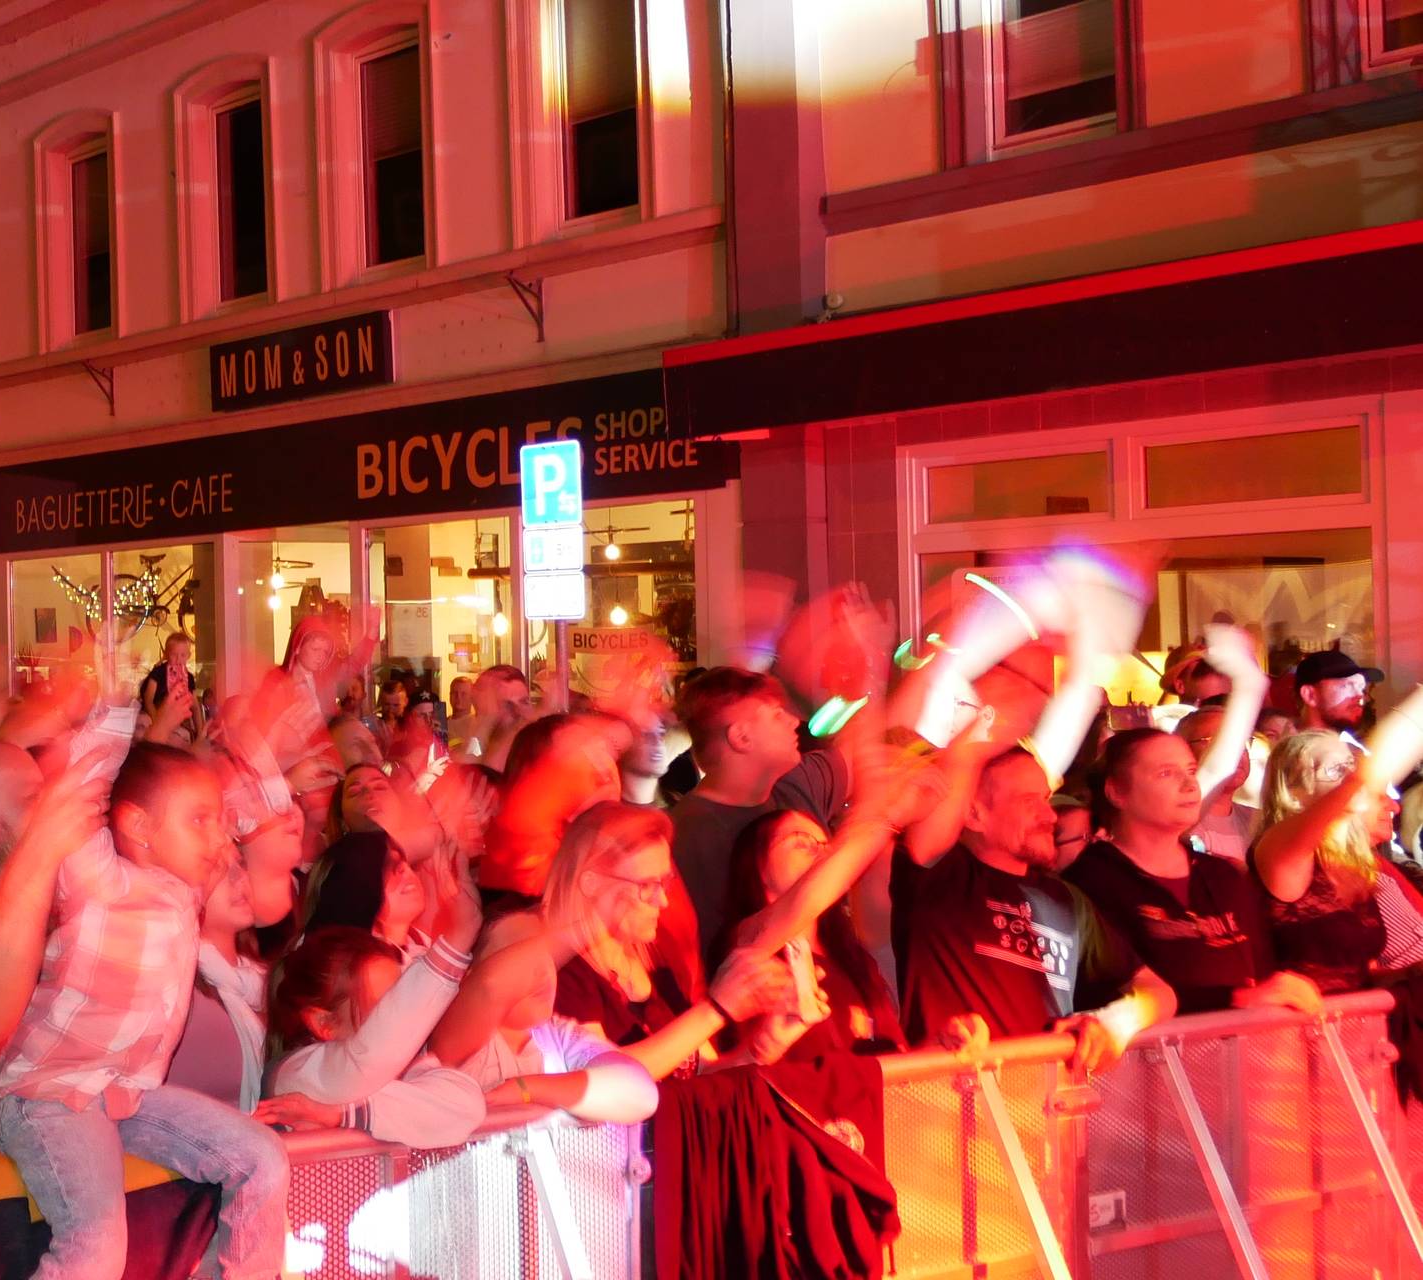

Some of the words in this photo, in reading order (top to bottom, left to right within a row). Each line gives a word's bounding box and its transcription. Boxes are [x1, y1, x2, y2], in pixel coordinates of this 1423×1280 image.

[220, 344, 282, 399] MOM
[292, 350, 305, 386] &
[314, 325, 374, 382] SON
[594, 406, 665, 442] SHOP
[594, 439, 698, 476] SERVICE
[16, 483, 154, 535] BAGUETTERIE
[171, 473, 234, 519] CAFE
[533, 454, 567, 517] P
[573, 632, 649, 649] BICYCLES
